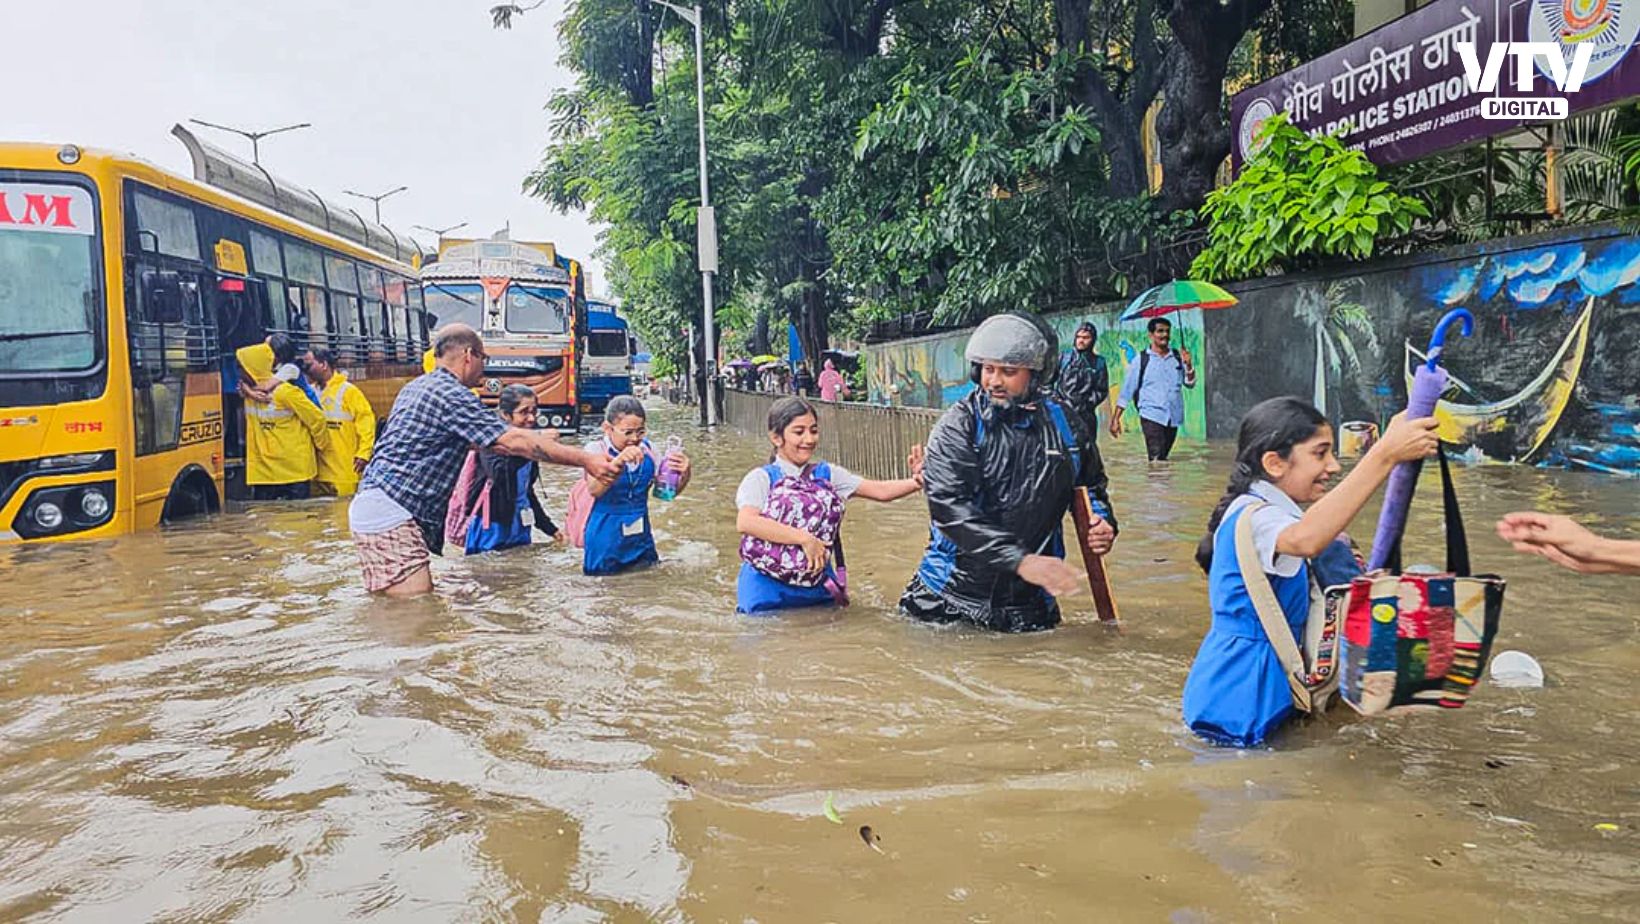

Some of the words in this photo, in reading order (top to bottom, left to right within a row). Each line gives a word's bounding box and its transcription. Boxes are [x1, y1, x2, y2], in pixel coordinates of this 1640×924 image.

[1283, 80, 1326, 125] शीव
[1331, 46, 1414, 105] पोलीस
[1326, 101, 1389, 138] POLICE
[488, 359, 535, 368] LEYLAND
[180, 421, 222, 442] CRUZIO
